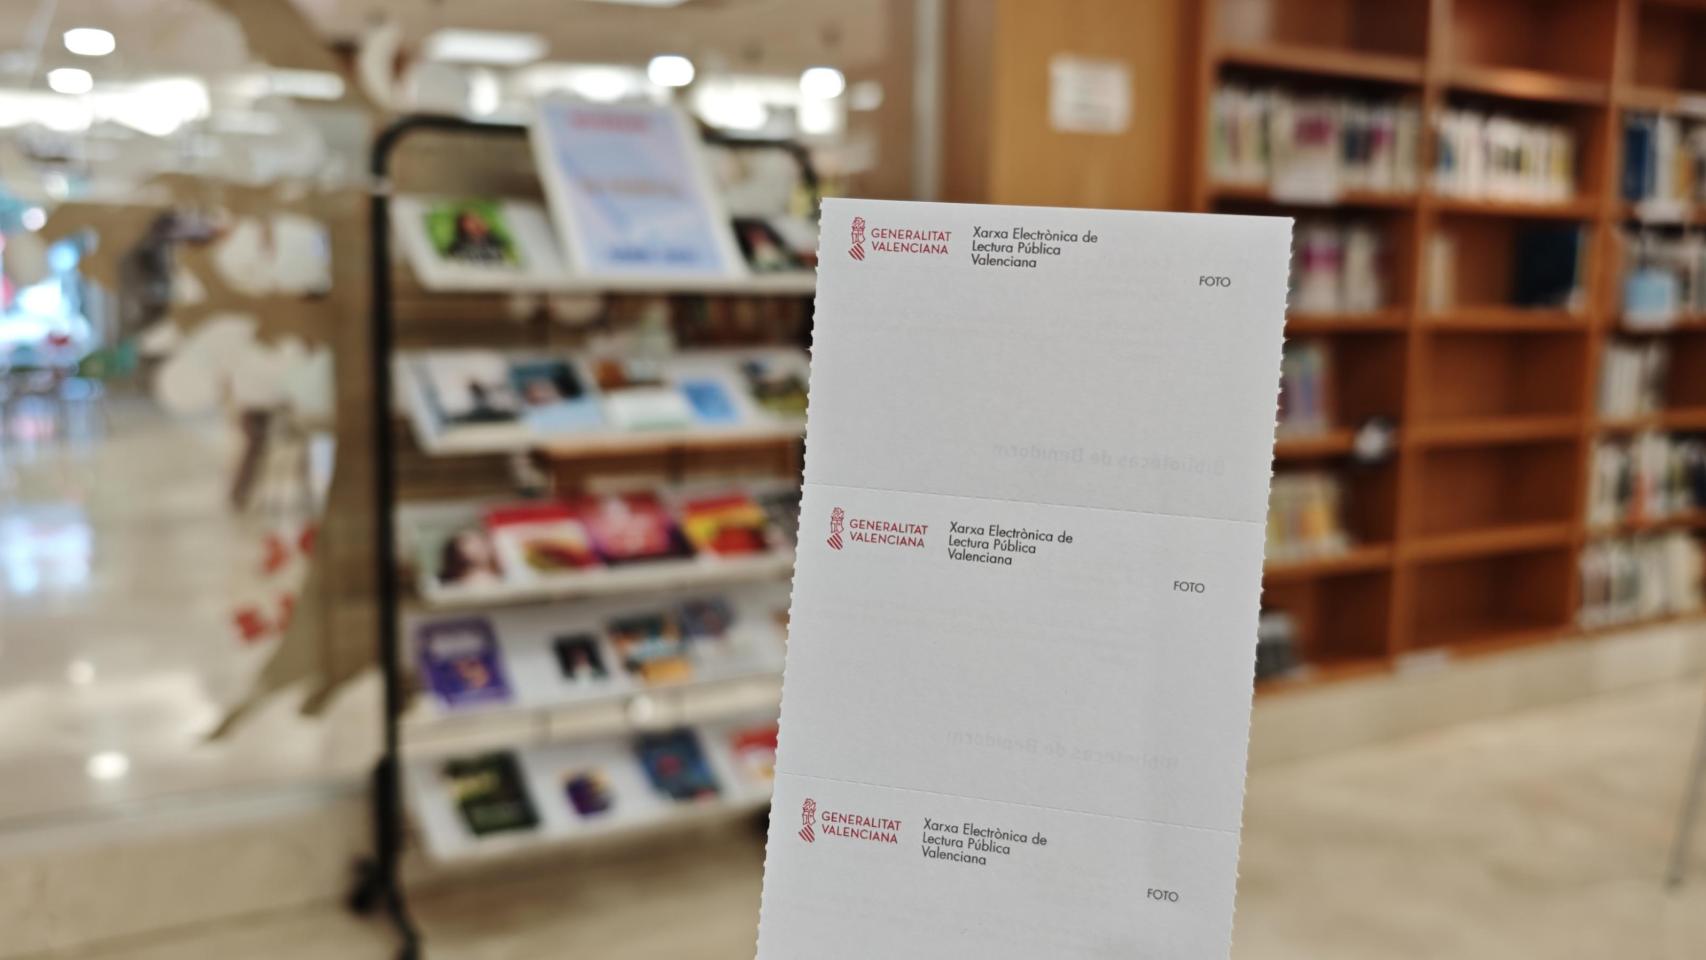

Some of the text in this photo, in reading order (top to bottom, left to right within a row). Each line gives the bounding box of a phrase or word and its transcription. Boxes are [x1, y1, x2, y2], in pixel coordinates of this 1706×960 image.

[871, 228, 952, 242] GENERALITAT
[973, 226, 1098, 243] Xarxa Electrònica de
[871, 241, 949, 254] VALENCIANA
[971, 239, 1061, 256] Lectura Pública
[971, 253, 1037, 268] Valenciana
[1199, 276, 1231, 288] FOTO
[849, 519, 928, 535] GENERALITAT
[950, 521, 1073, 544] Xarxa Electrònica de
[849, 532, 925, 548] VALENCIANA
[948, 534, 1036, 554] Lectura Pública
[948, 548, 1012, 566] Valenciana
[1174, 580, 1205, 593] FOTO
[821, 811, 902, 831] GENERALITAT
[821, 824, 898, 844] VALENCIANA
[923, 818, 1048, 846] Xarxa Electrònica de
[922, 831, 1011, 855] Lectura Pública
[921, 845, 987, 866] Valenciana
[1146, 889, 1178, 903] FOTO
